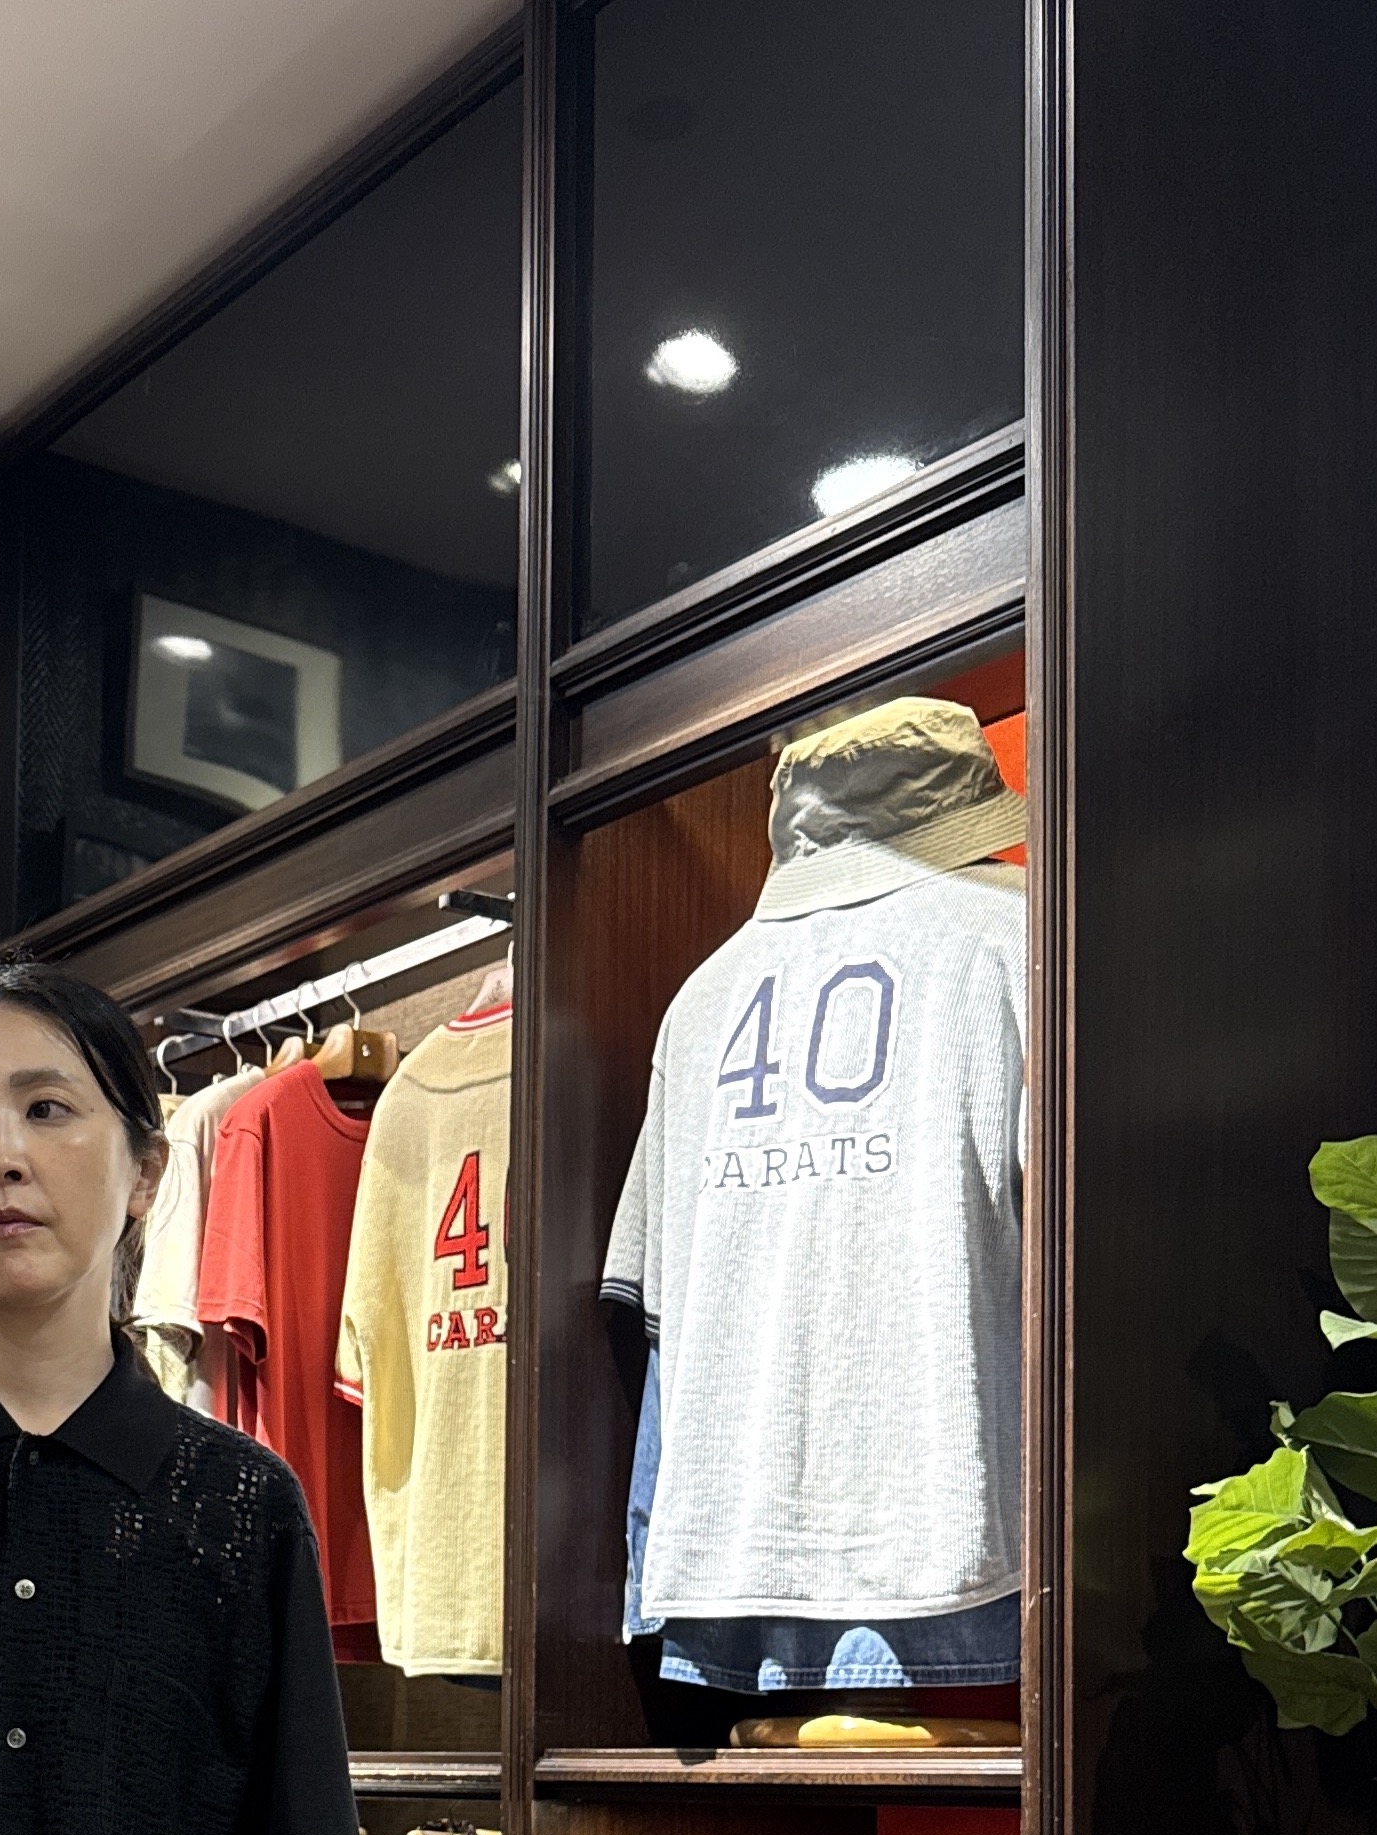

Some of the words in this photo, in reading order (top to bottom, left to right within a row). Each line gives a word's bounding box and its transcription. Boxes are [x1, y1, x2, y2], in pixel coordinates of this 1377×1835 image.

[717, 960, 895, 1120] 40
[433, 1150, 510, 1290] 4
[426, 1306, 506, 1352] CAR
